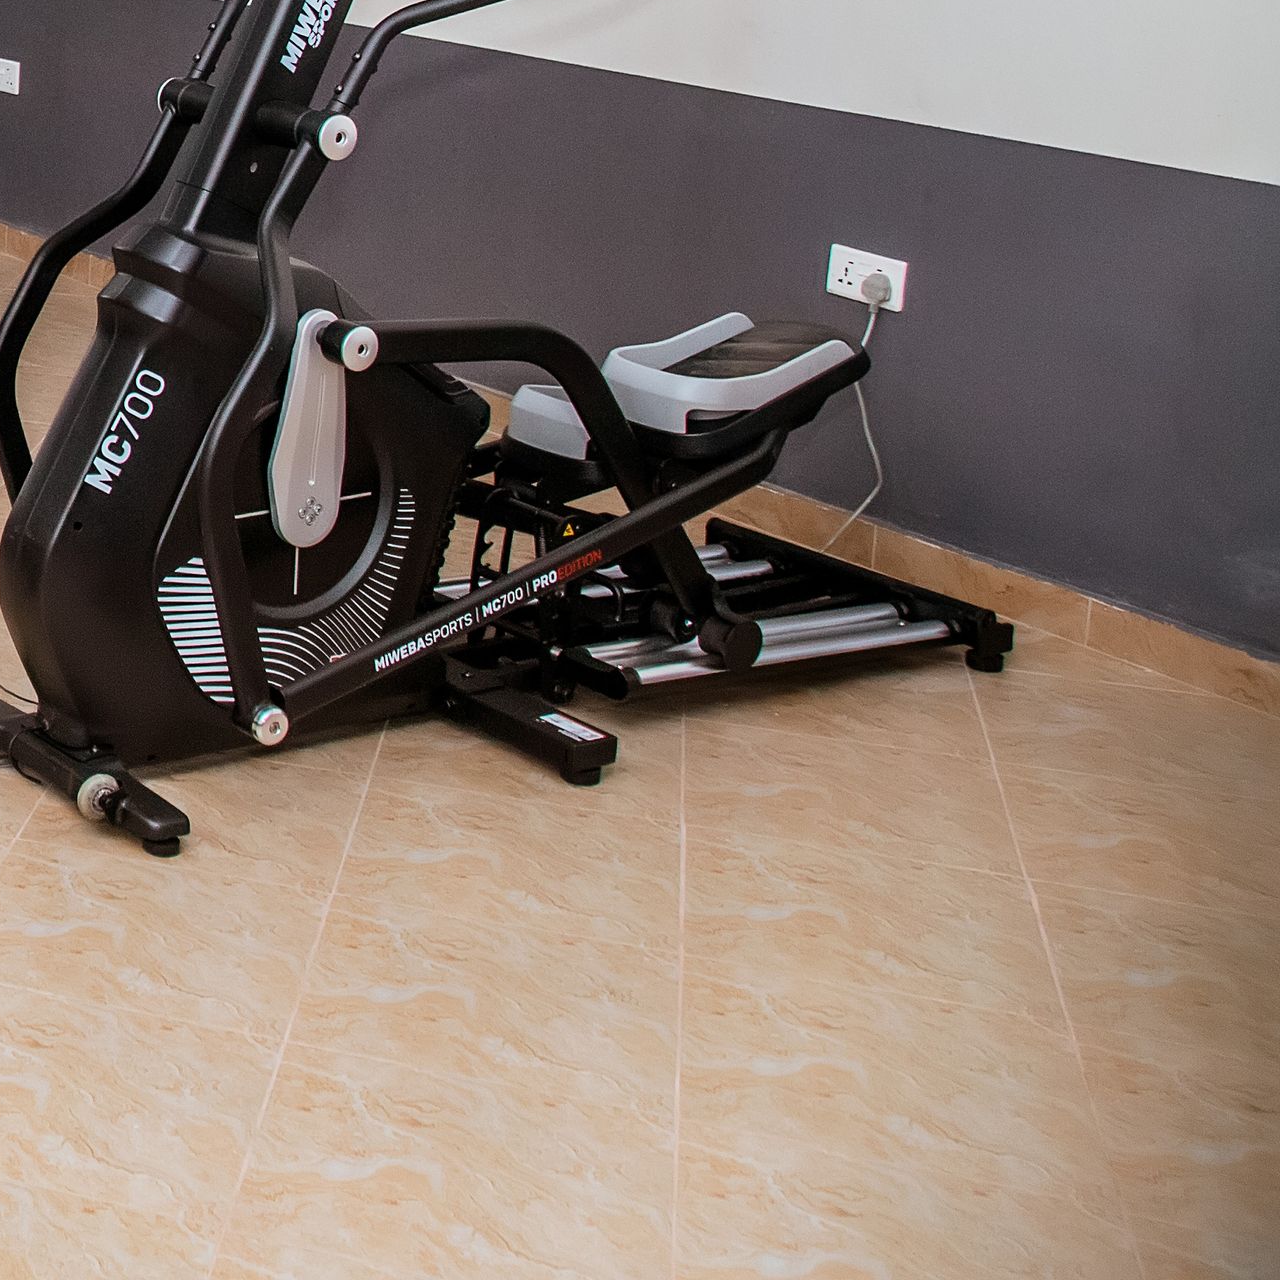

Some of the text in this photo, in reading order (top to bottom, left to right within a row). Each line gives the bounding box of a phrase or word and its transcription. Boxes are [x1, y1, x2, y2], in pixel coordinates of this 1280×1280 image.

[84, 369, 165, 495] MC700
[374, 613, 473, 672] MIWEBASPORTS
[482, 587, 524, 618] MC700
